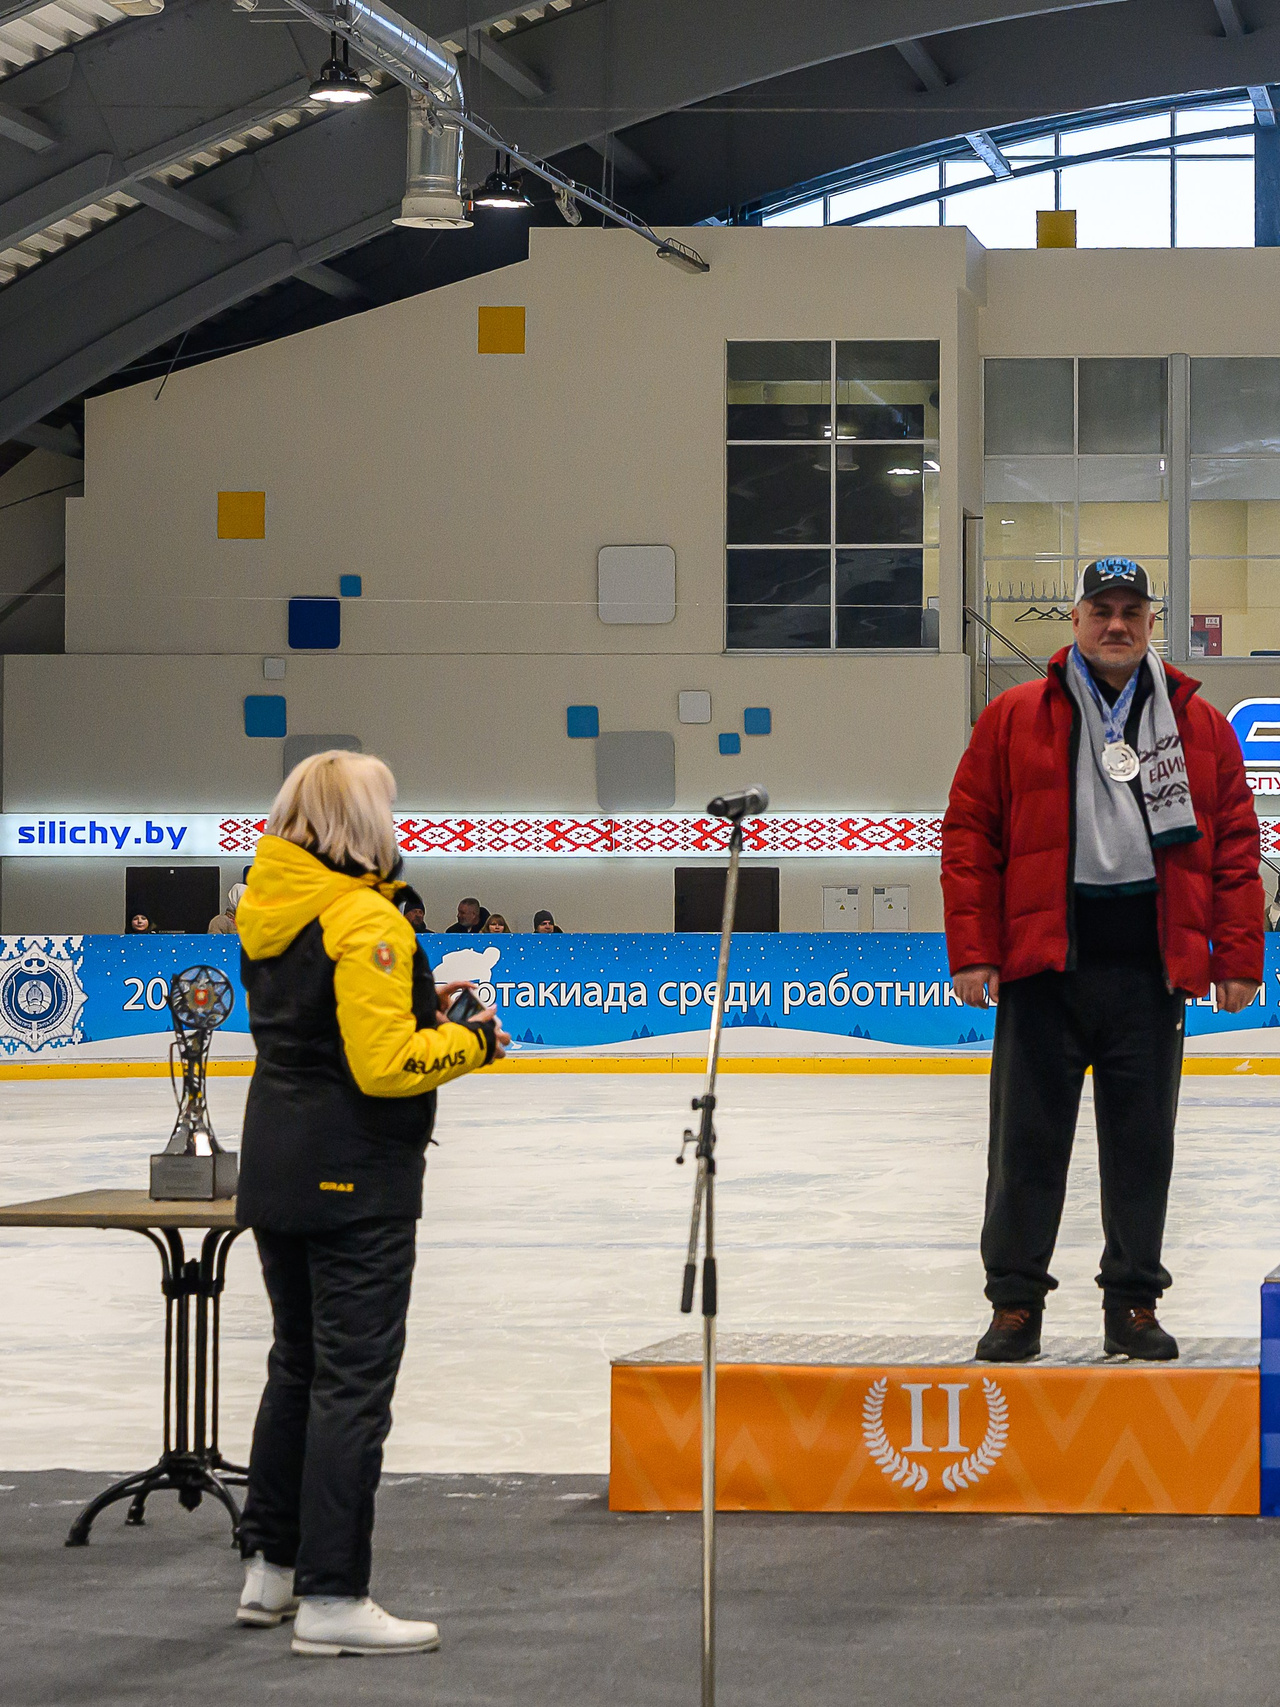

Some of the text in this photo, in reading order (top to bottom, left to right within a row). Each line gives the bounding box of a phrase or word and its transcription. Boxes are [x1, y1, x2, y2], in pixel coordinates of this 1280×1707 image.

[18, 820, 188, 850] silichy.by
[658, 981, 771, 1015] среди
[782, 971, 997, 1016] работник
[901, 1383, 970, 1453] II
